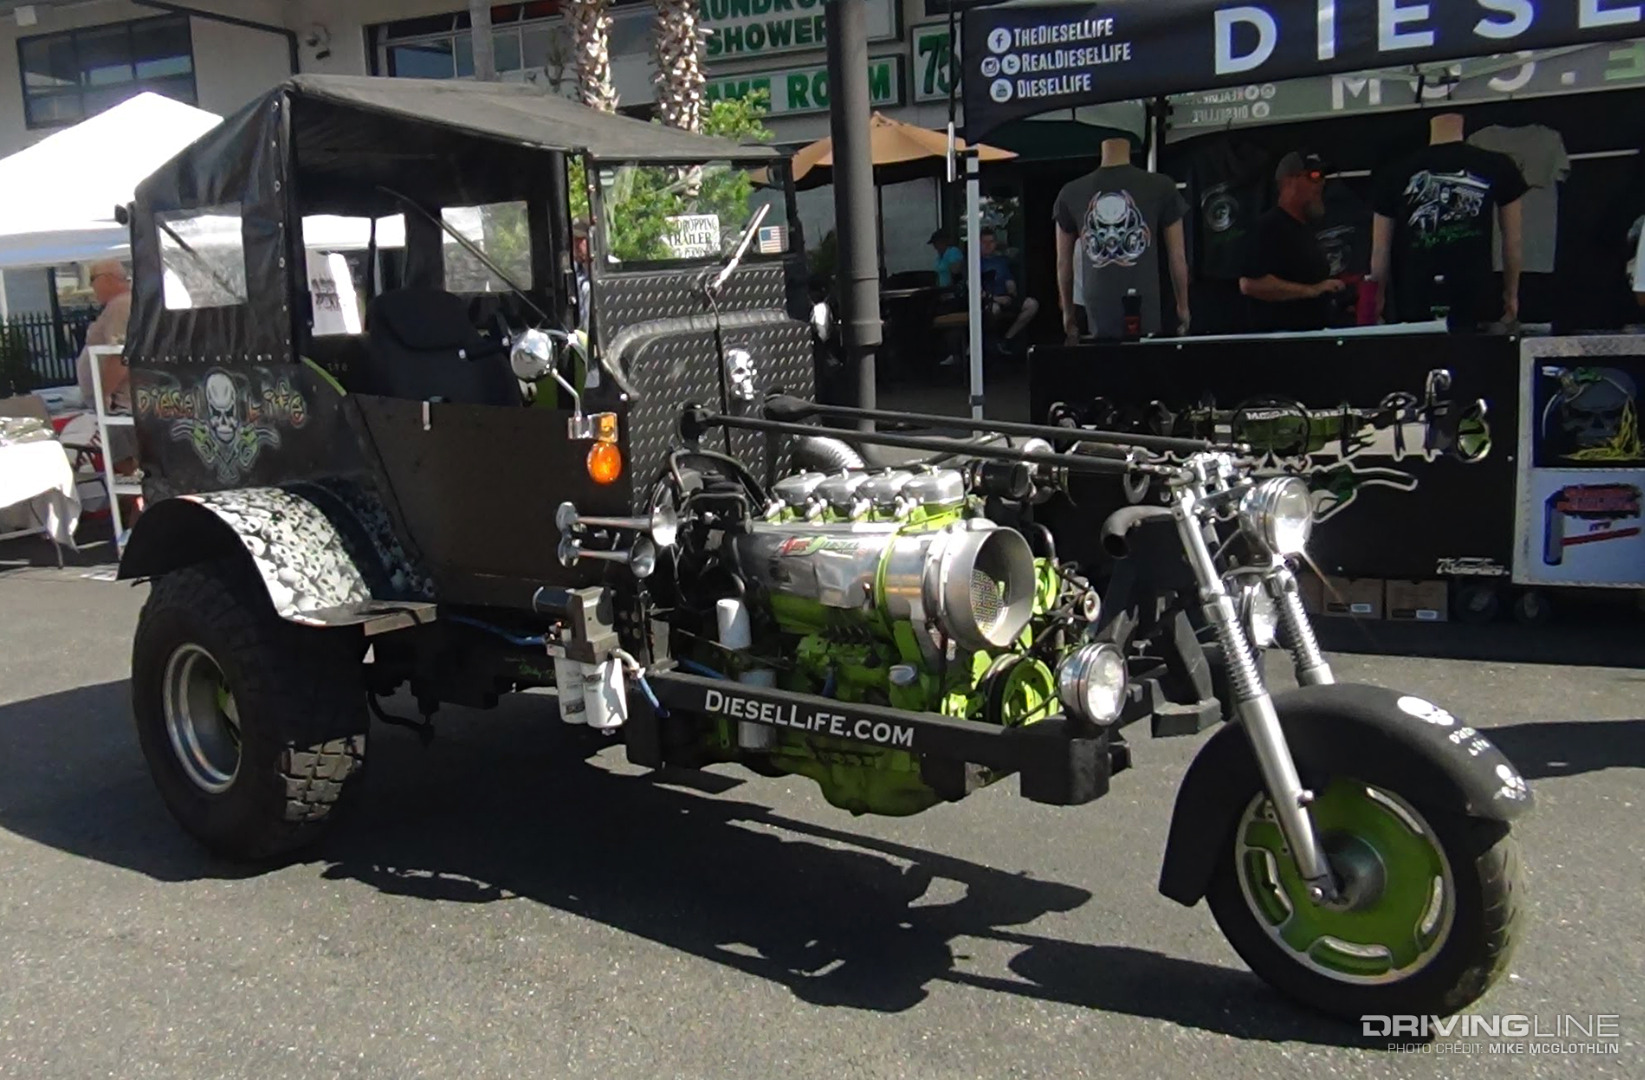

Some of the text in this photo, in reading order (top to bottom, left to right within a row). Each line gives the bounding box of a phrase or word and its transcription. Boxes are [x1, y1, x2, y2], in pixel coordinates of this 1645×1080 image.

[704, 64, 890, 112] AME ROM
[705, 690, 915, 747] DIESELLIFE.COM
